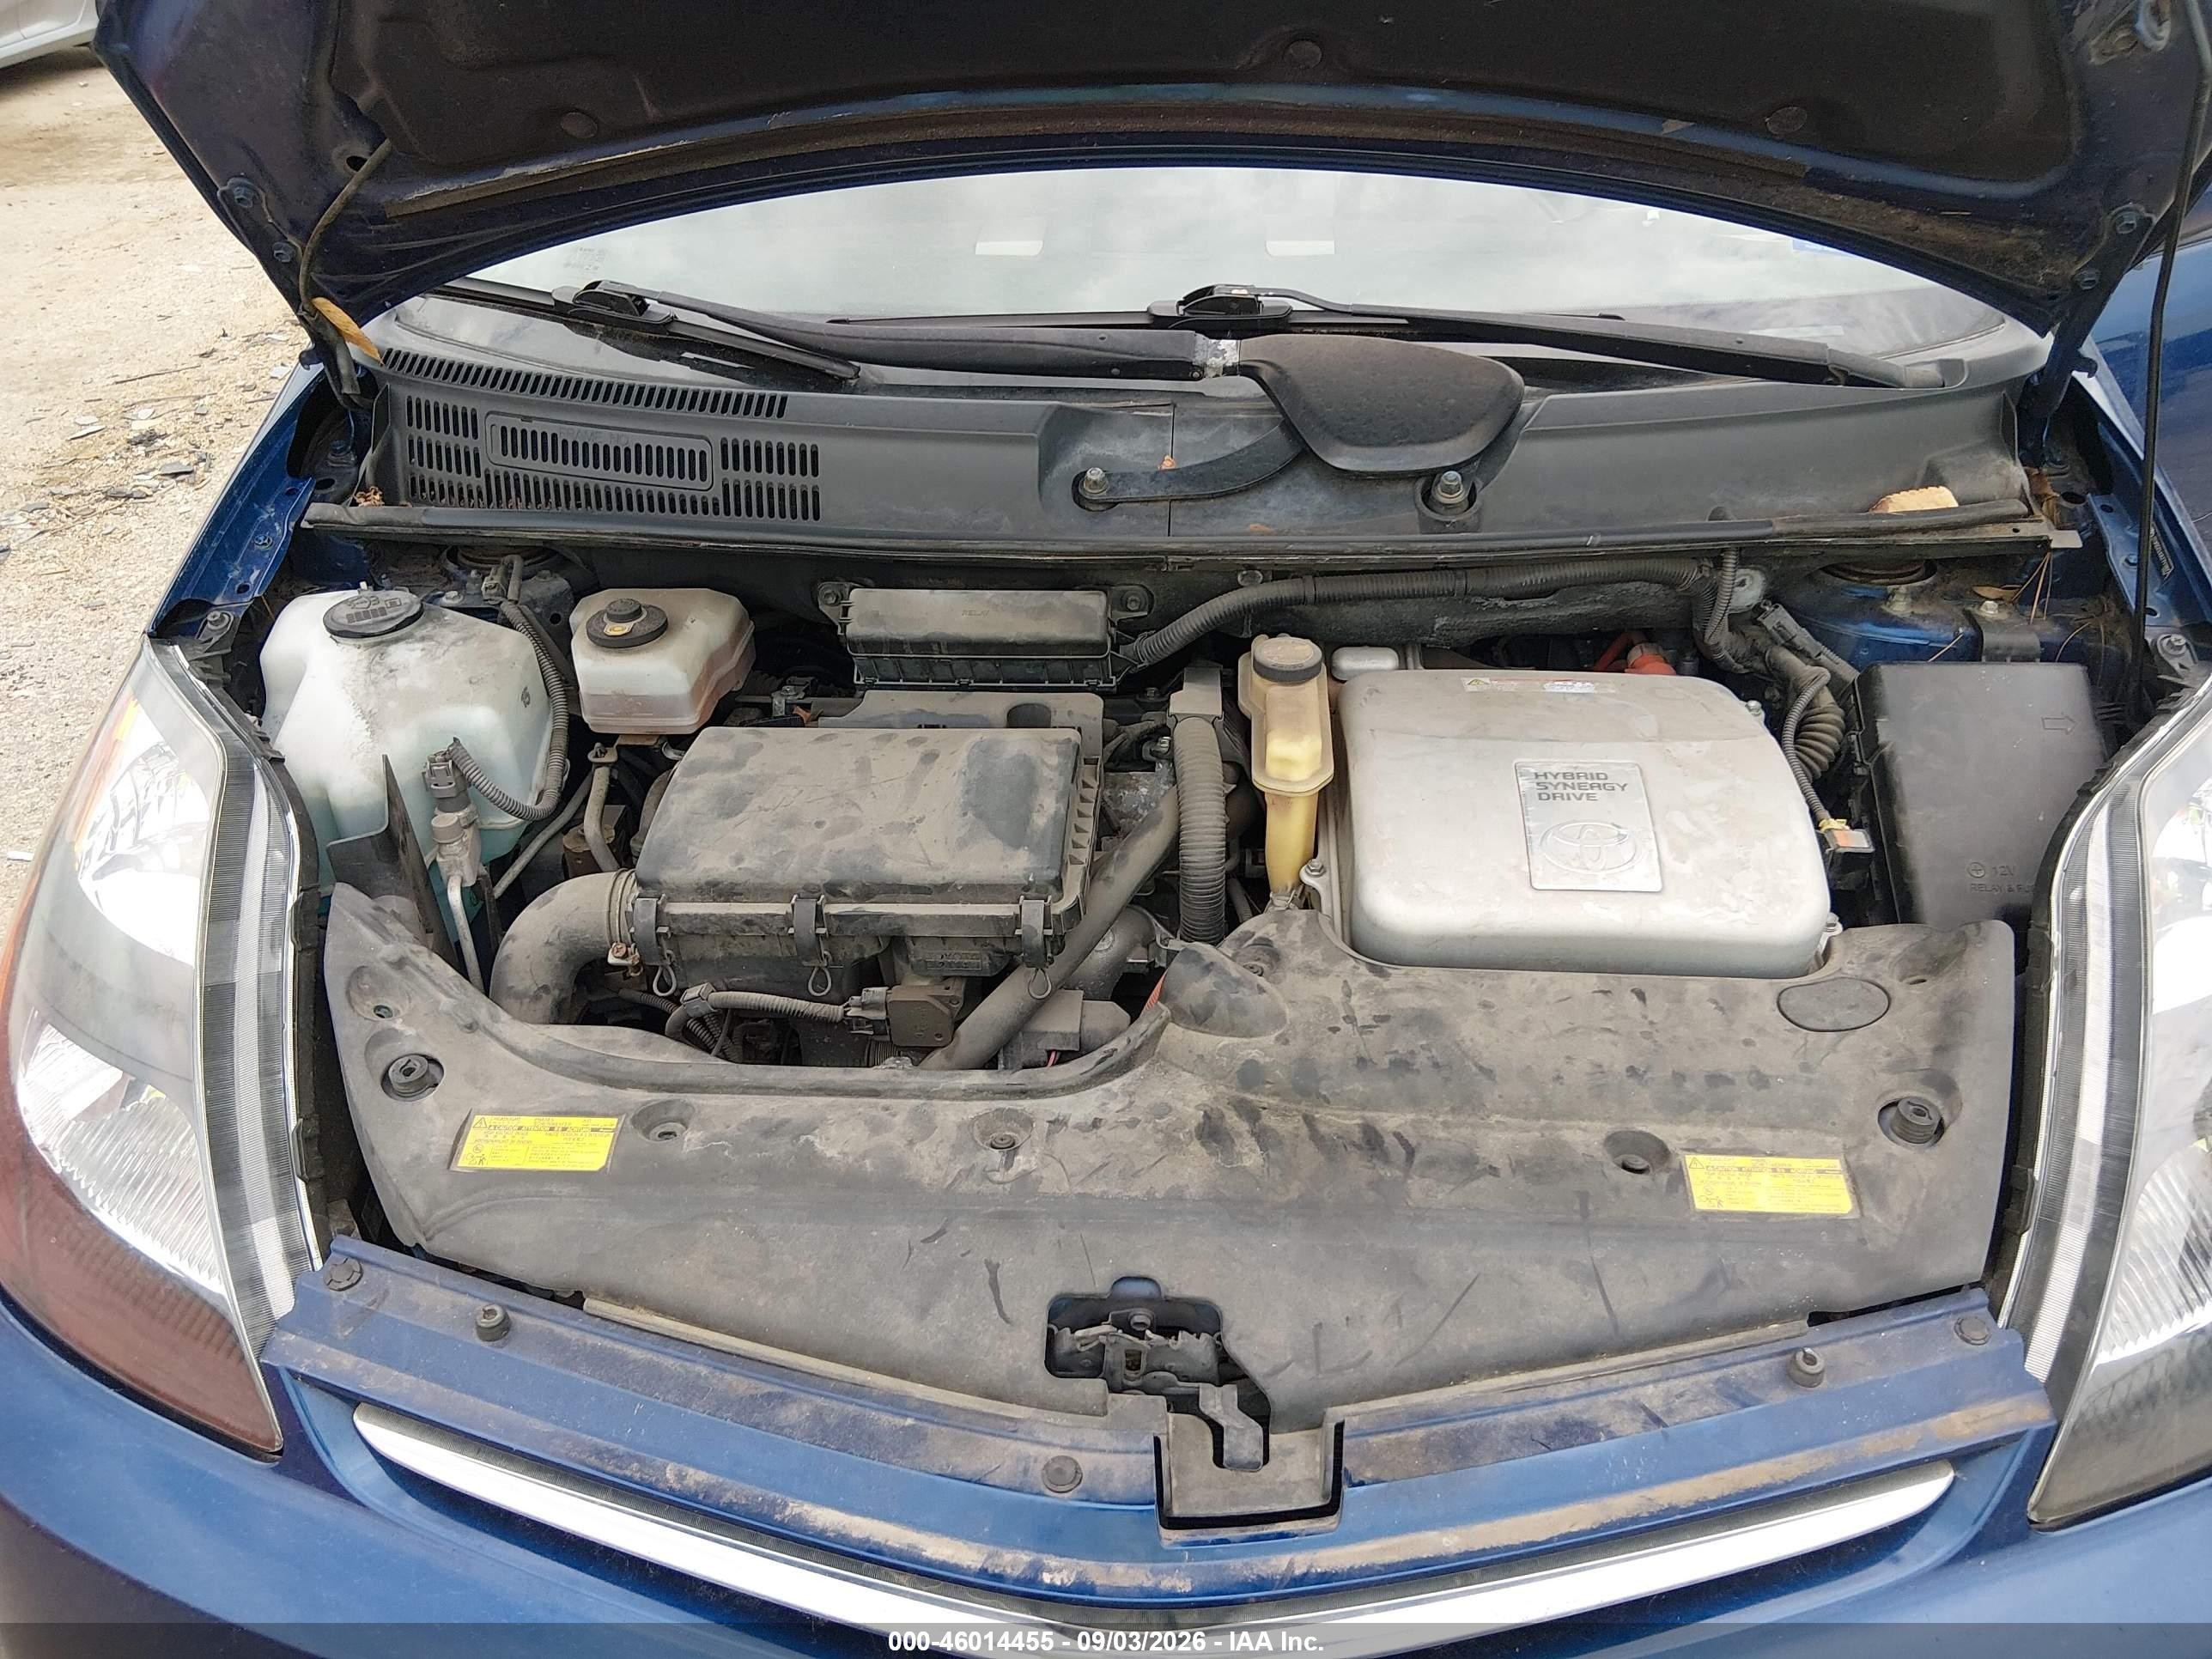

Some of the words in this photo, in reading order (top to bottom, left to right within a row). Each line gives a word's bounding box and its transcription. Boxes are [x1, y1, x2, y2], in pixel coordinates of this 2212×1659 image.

[1534, 771, 1608, 781] HYBRID
[1535, 781, 1629, 792] SYNERGY
[1538, 792, 1598, 801] DRIVE
[1991, 865, 2016, 877] 12V
[1970, 883, 2005, 893] RELAY
